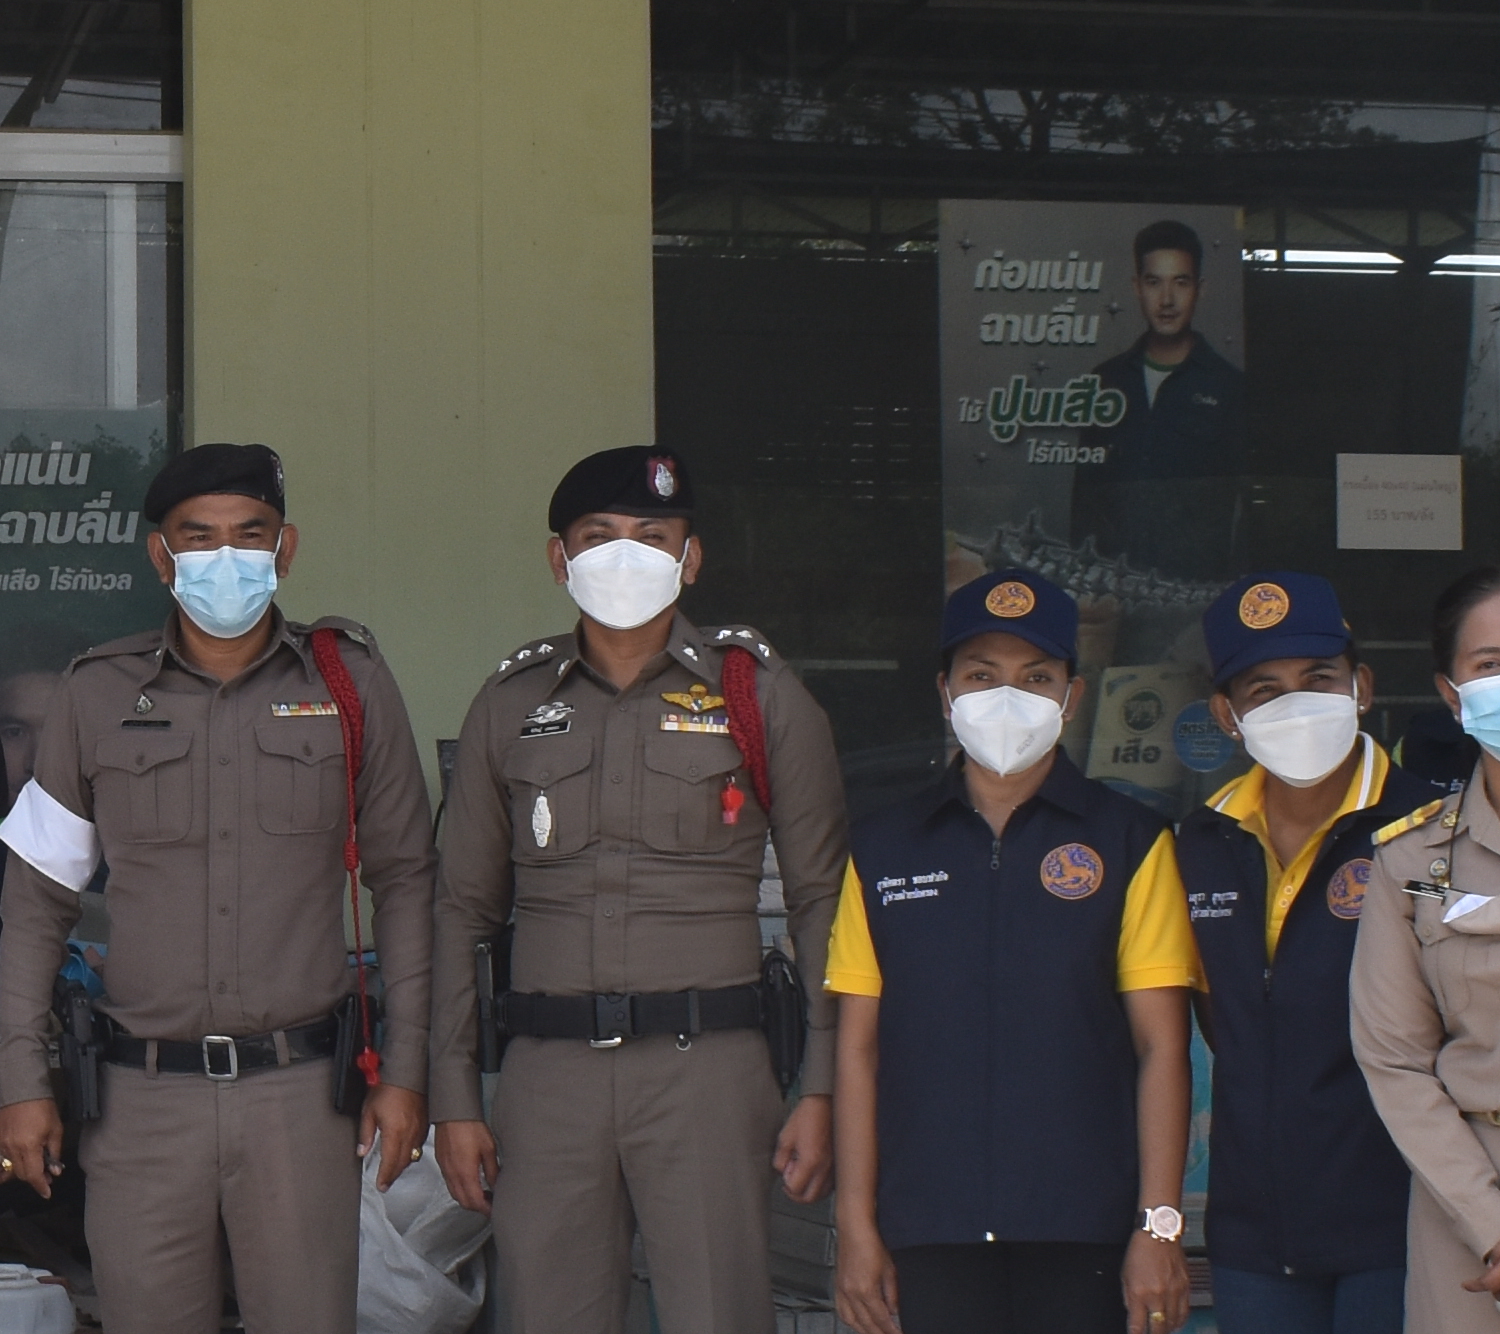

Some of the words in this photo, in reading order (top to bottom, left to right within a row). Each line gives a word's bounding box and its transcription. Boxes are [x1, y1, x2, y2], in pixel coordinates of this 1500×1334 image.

[973, 251, 1103, 290] ก่อแน่น
[980, 298, 1100, 345] ฉาบลื่น
[958, 397, 986, 423] ใช้
[988, 375, 1127, 443] ปูนเสือ
[1027, 439, 1106, 464] ไร้กังวล
[49, 566, 133, 592] ไร้กังวล
[1111, 737, 1162, 764] เสือ
